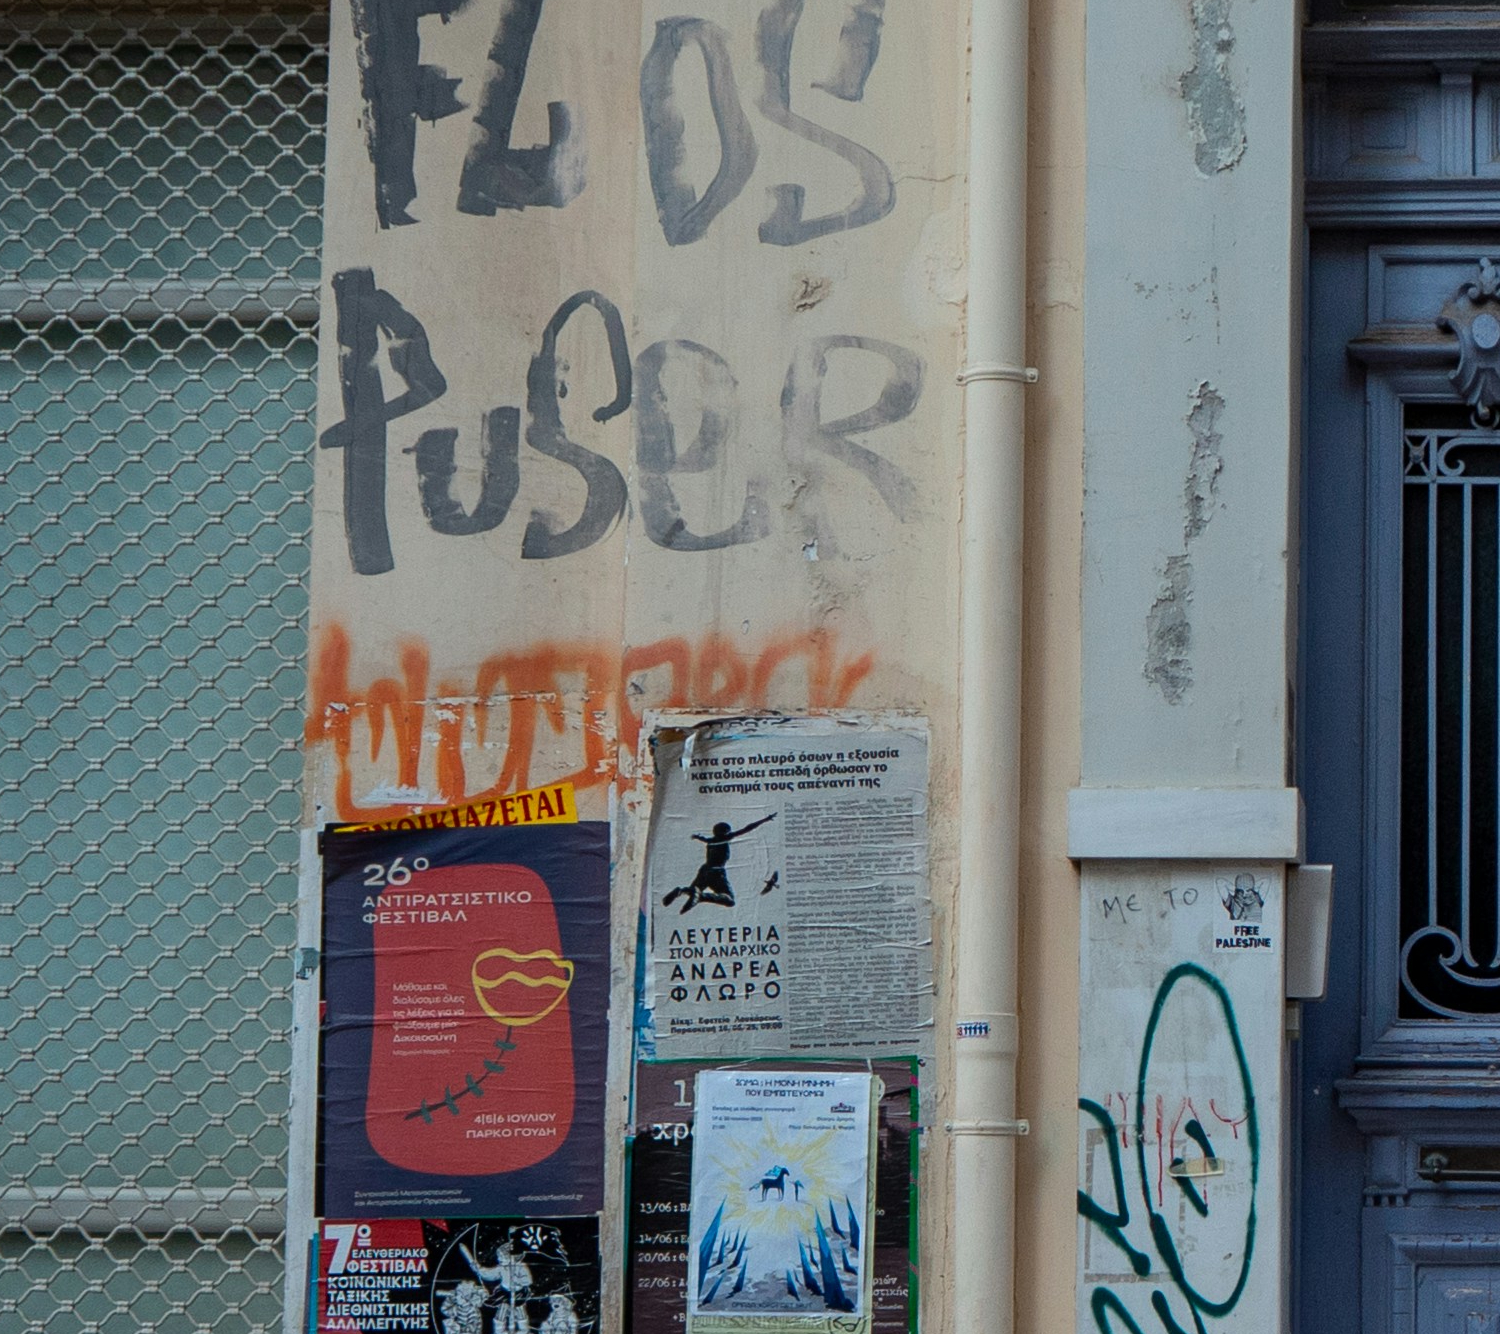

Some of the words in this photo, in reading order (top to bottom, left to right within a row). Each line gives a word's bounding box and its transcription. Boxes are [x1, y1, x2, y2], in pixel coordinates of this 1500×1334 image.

[679, 755, 719, 768] άντα
[722, 755, 745, 767] στο
[748, 751, 796, 766] πλευρό
[799, 749, 833, 762] όσων
[836, 752, 845, 764] η
[847, 747, 899, 762] εξουσία
[691, 767, 766, 782] καταδιώκει
[769, 765, 811, 781] επειδή
[813, 762, 871, 777] όρθωσαν
[873, 763, 888, 774] το
[699, 779, 761, 794] ανάστημά
[764, 781, 795, 793] τους
[858, 777, 881, 790] της
[354, 787, 567, 833] ΝΟΙΚΙΑΖΕΤΑΙ
[362, 890, 532, 909] ΑΝΤΙΡΑΤΣΙΣΤΙΚΟ
[362, 909, 468, 924] ΦΕΣΤΙΒΑΛ
[669, 925, 780, 945] ΛΕΥΤΕΡΙΑ
[1234, 926, 1260, 936] FREE
[1215, 938, 1272, 948] PALESTINE
[669, 946, 706, 960] ΣΤΟΝ
[709, 944, 781, 958] ΑΝΑΡΧΙΚΟ
[670, 960, 781, 982] ΑΝΔΡΕΑ
[669, 981, 781, 1002] ΦΛΩΡΟ
[506, 1112, 556, 1123] ΙΟΥΛΙΟΥ
[466, 1128, 512, 1139] ΠΑΡΚΟ
[514, 1126, 556, 1138] ΓΟΥΔΗ
[352, 1248, 429, 1258] ΕΛΕΥΘΕΡΙΑΚΟ
[347, 1259, 428, 1273] ΦΕΣΤΙΒΑΛ
[327, 1275, 421, 1289] ΚΟΙΝΩΝΙΚΗΣ
[327, 1290, 390, 1303] ΤΑΞΙΚΗΣ
[326, 1303, 429, 1317] ΔΙΕΘΝΙΣΤΙΚΗΣ
[326, 1317, 430, 1332] ΑΛΛΗΛΕΓΓΥΗΣ
